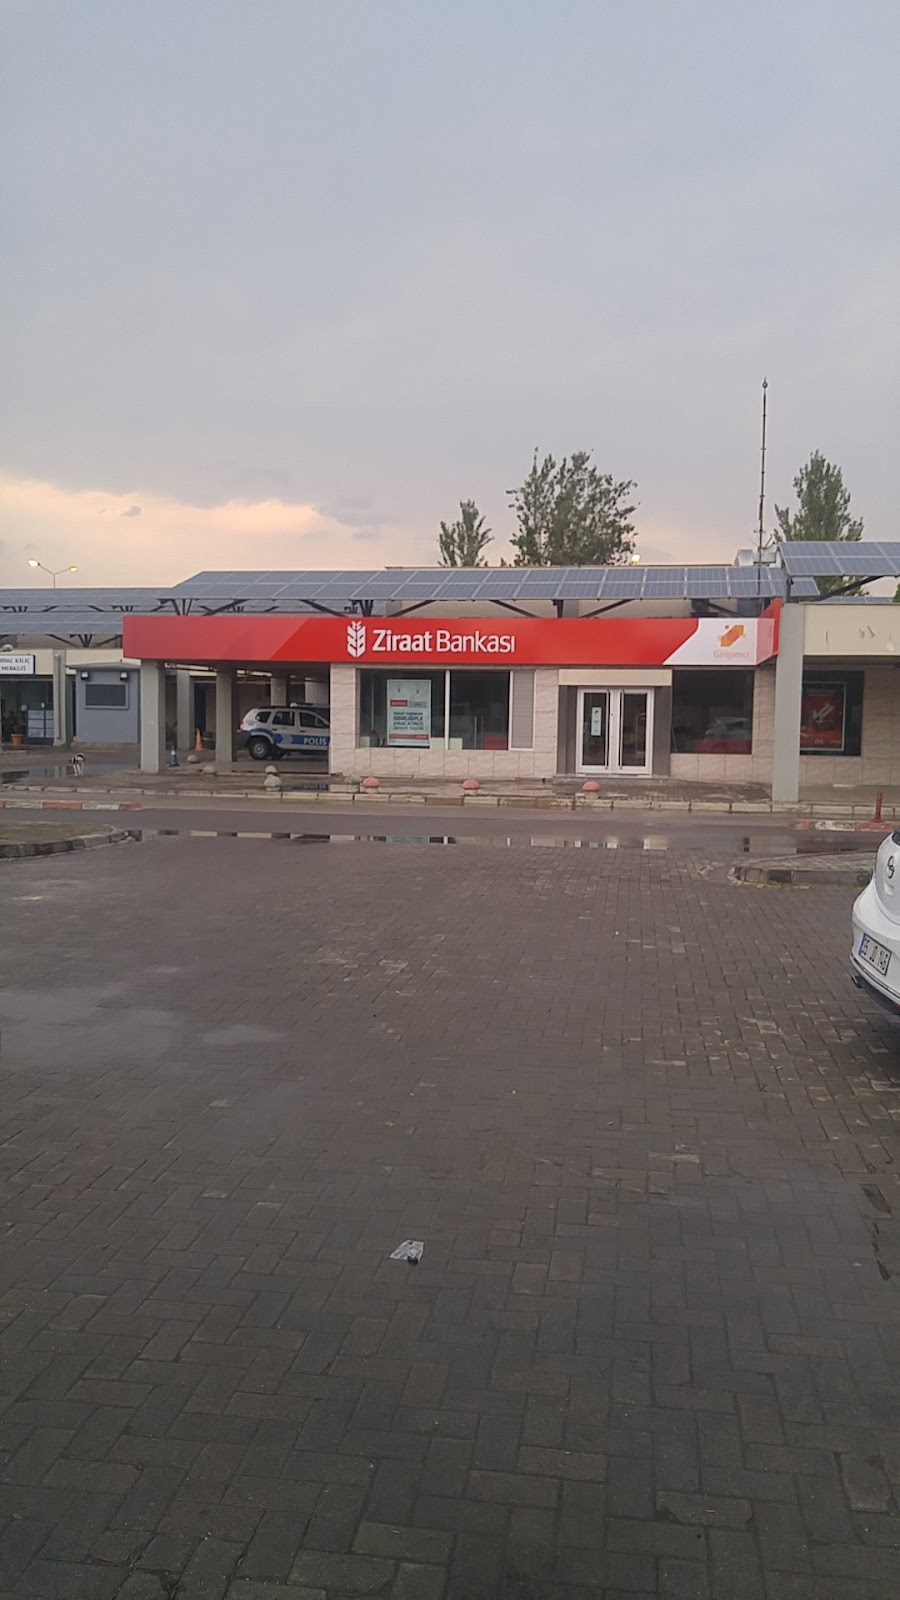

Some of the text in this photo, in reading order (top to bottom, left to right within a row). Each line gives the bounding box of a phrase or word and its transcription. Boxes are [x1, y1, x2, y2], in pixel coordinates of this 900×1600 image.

[372, 629, 516, 653] Ziraat Bankası
[303, 736, 327, 746] POLİS
